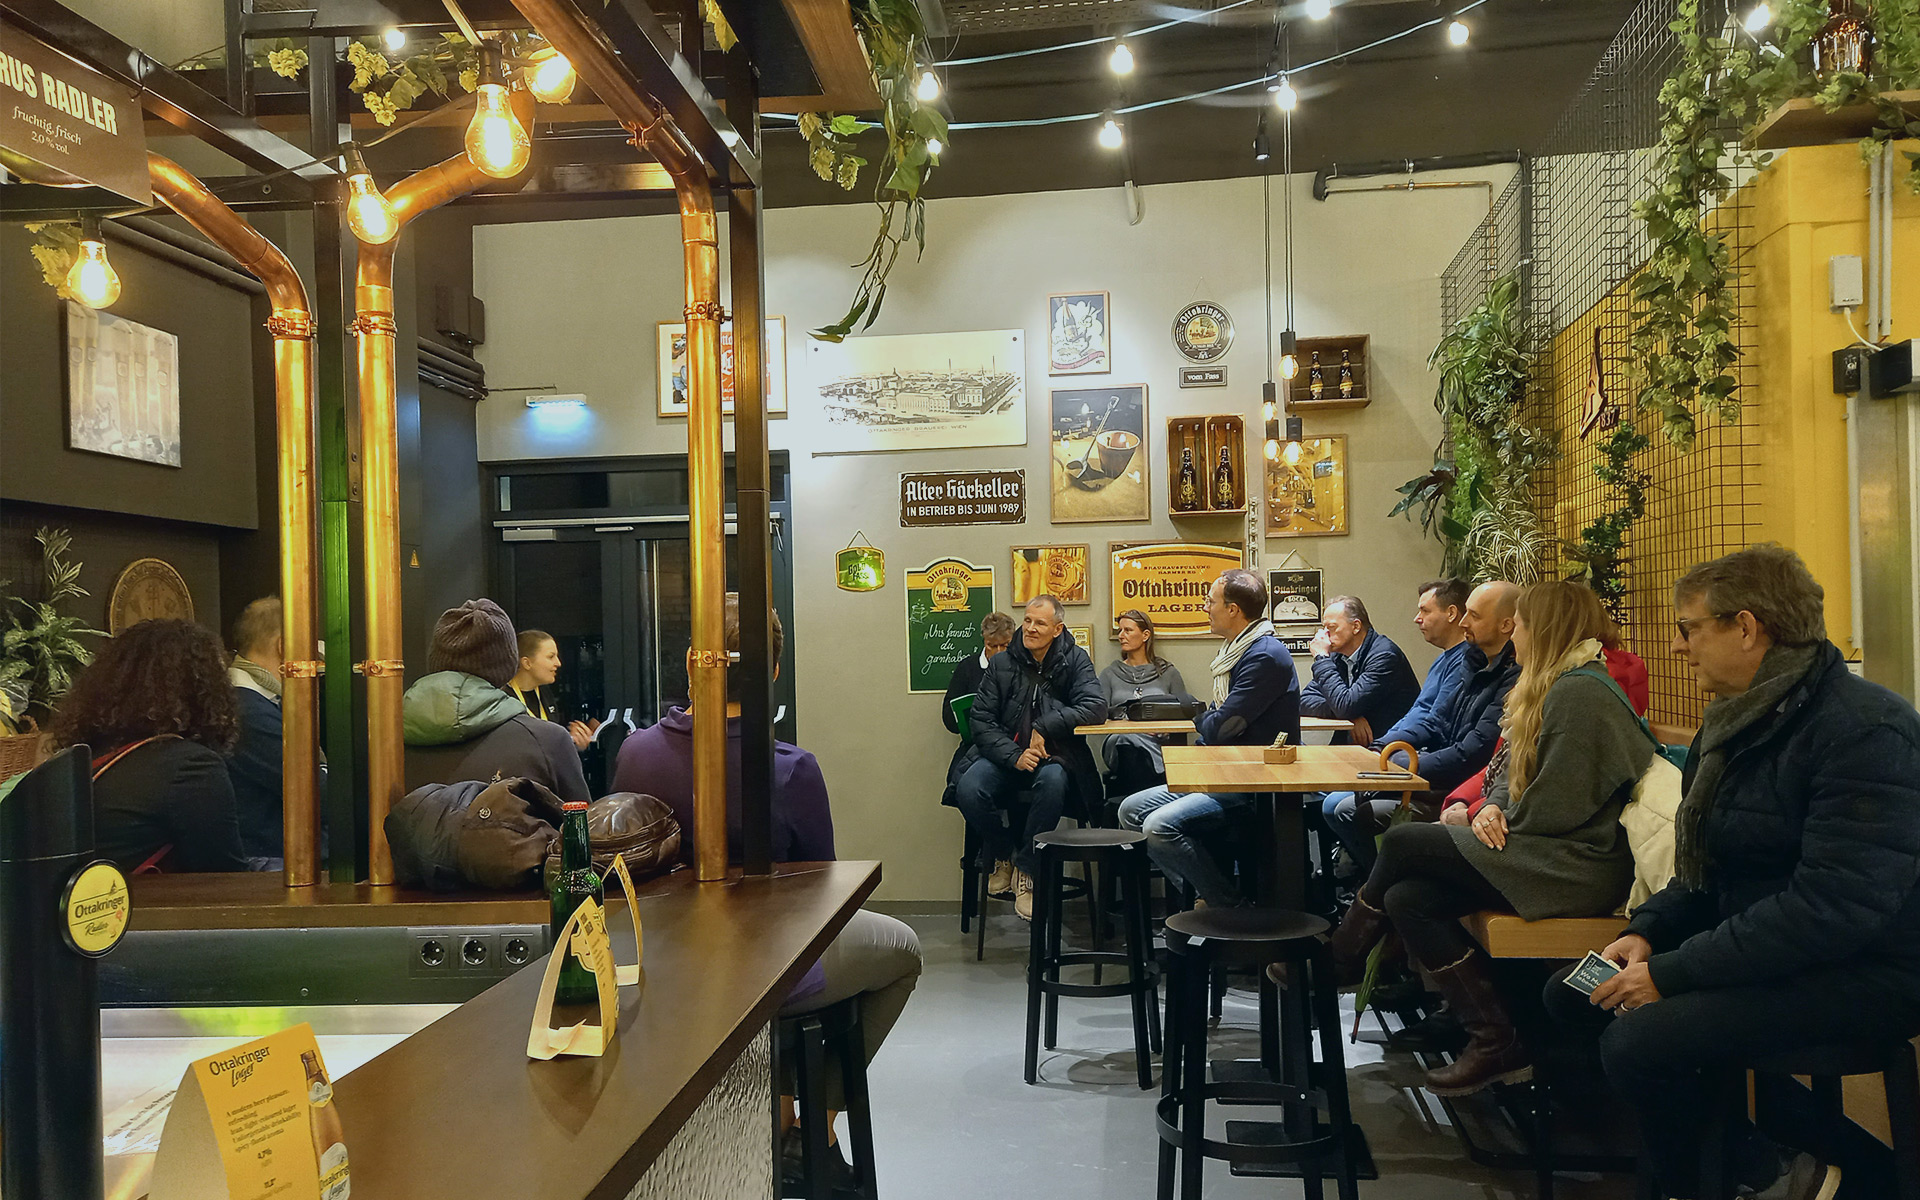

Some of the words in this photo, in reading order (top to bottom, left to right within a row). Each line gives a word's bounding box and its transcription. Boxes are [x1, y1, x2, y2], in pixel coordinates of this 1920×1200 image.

[41, 71, 118, 136] RADLER
[13, 106, 54, 135] fruchtig,
[55, 125, 82, 145] frisch
[1205, 372, 1220, 380] Fass
[905, 480, 944, 503] Alter
[946, 477, 1019, 499] Gärkeller
[907, 506, 917, 517] IN
[918, 504, 956, 516] BETRIEB
[957, 504, 973, 515] BIS
[975, 503, 997, 515] JUNI
[999, 503, 1020, 516] 1989
[926, 565, 973, 584] Ottakringer
[1148, 604, 1206, 613] LAGER
[940, 638, 956, 650] du
[75, 896, 125, 919] Ottakringer
[1580, 970, 1591, 979] Wo
[209, 1046, 271, 1076] Ottakringer
[231, 1063, 255, 1088] Lager
